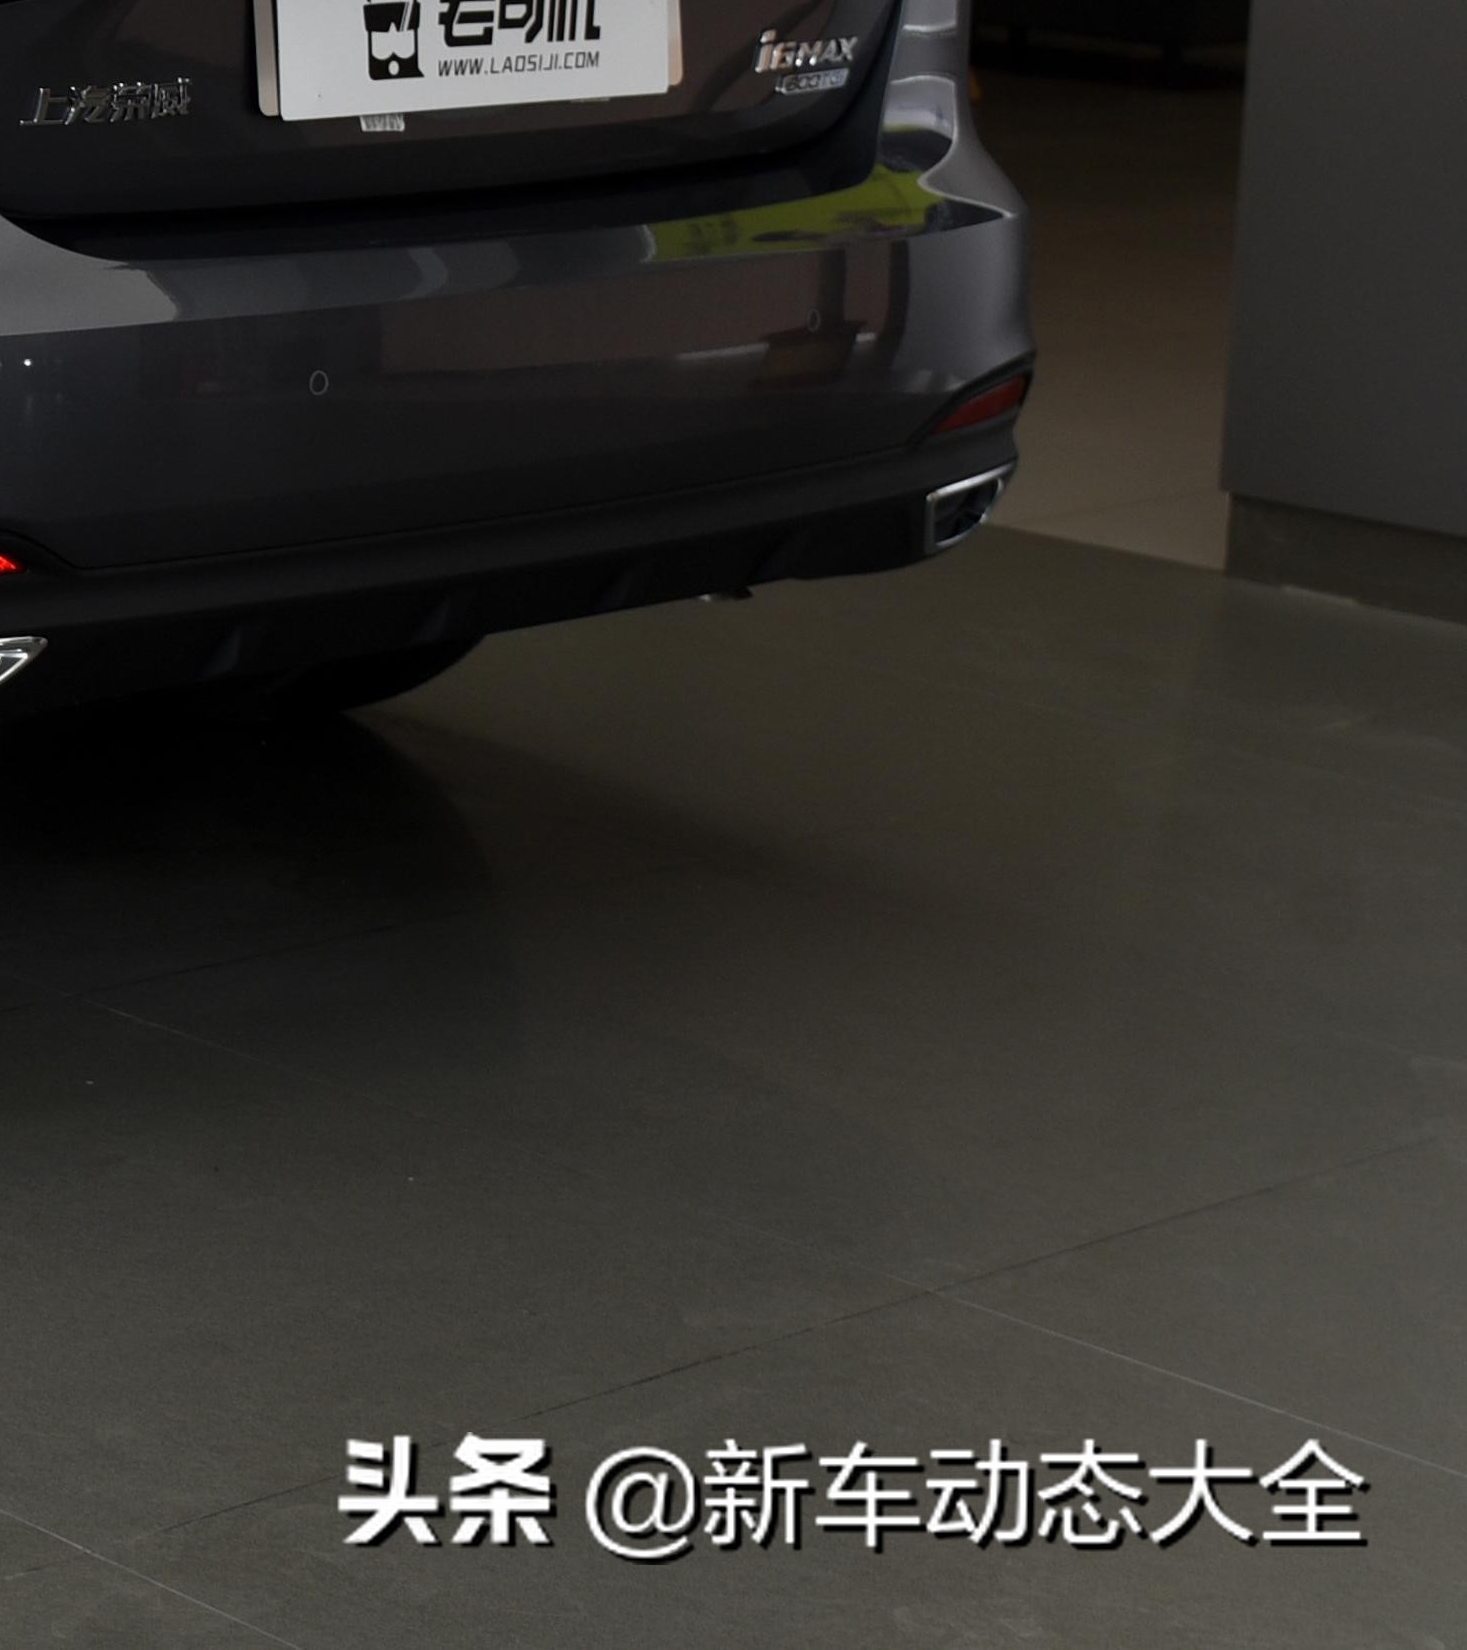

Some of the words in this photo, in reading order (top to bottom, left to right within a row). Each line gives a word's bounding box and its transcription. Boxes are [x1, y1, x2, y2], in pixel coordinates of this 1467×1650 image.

[438, 51, 601, 77] WWW.LAOSIJI.COM
[19, 77, 192, 125] 上汽荣威
